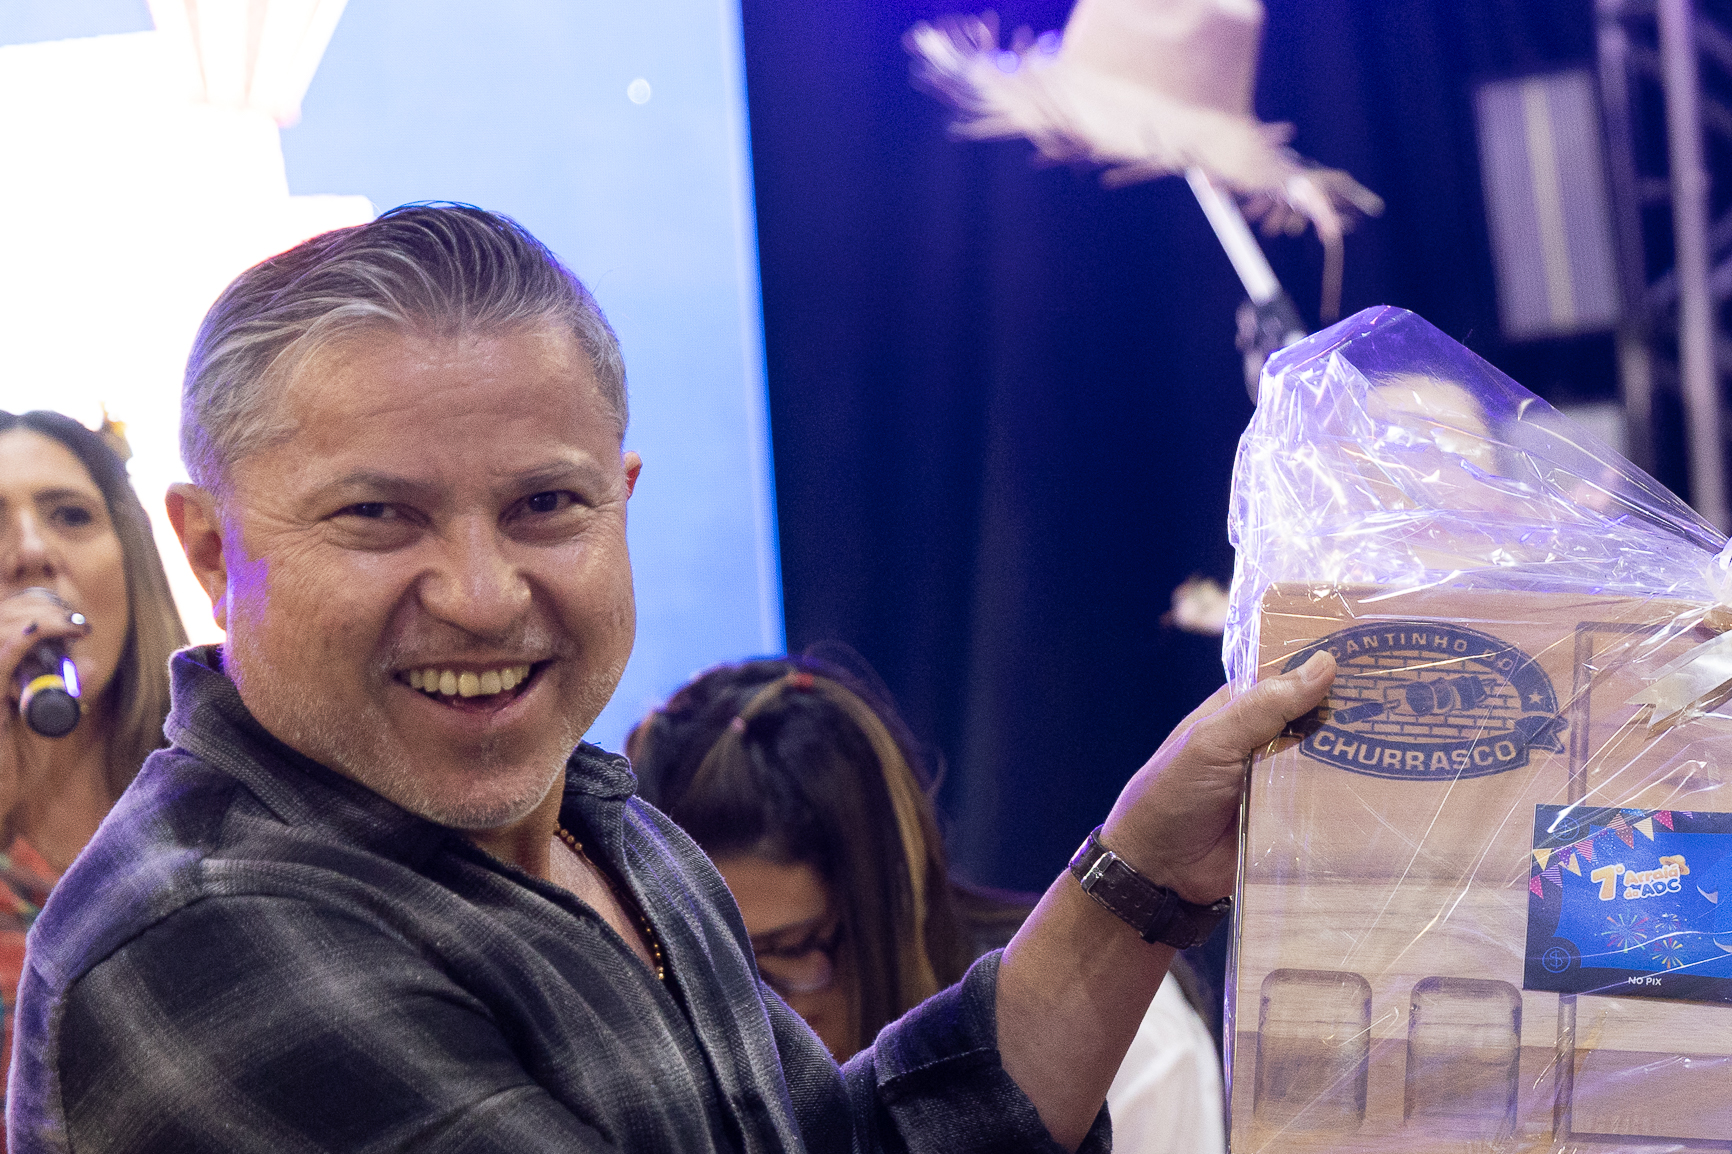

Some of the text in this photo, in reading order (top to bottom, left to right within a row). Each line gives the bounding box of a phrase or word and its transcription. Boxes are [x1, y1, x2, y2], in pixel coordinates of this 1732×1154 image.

[1327, 632, 1468, 658] CANTINHO
[1312, 731, 1517, 772] CHURRASCO
[1641, 878, 1680, 898] ADC
[1628, 976, 1662, 987] NO PIX
